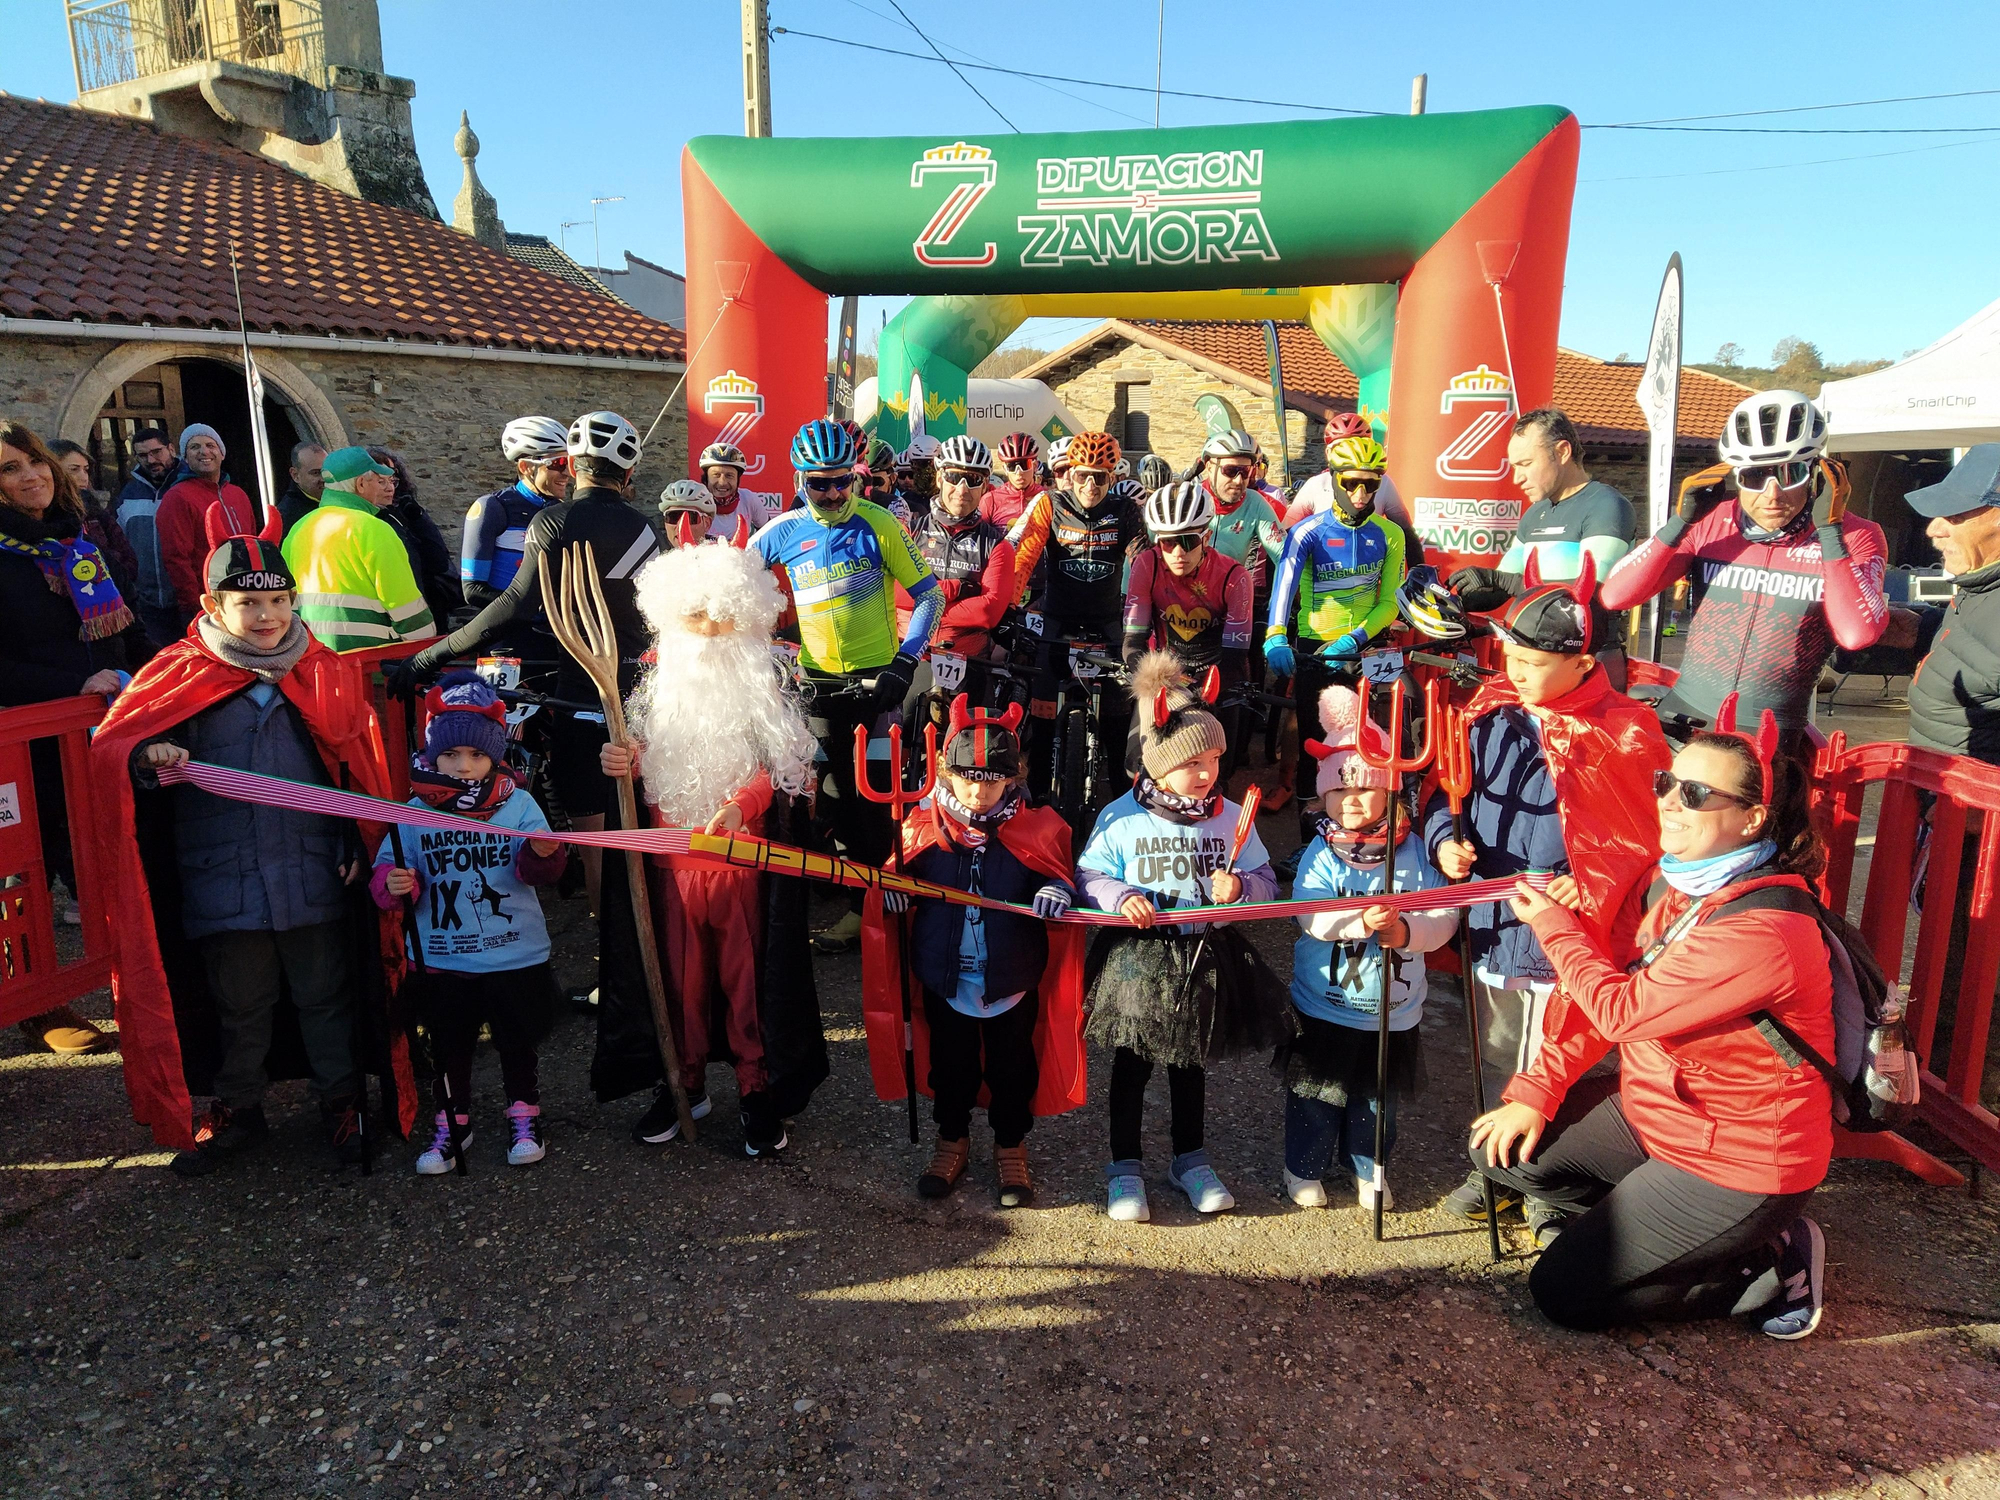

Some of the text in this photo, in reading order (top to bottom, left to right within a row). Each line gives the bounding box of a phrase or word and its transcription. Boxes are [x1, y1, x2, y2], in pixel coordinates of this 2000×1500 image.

[1017, 207, 1281, 267] ZAMORA
[1907, 395, 1977, 408] SmartChip
[967, 404, 1025, 421] martChip
[950, 559, 981, 573] RURAL
[1316, 560, 1343, 573] MTB
[237, 571, 287, 589] UFONES
[1703, 561, 1825, 602] VINTOROBIKE
[936, 663, 961, 681] 171
[1373, 661, 1394, 677] 74
[487, 672, 507, 687] 18
[961, 770, 1006, 781] UFONES
[420, 830, 481, 852] MARCHA
[1135, 837, 1226, 856] MARCHA MTB
[425, 844, 512, 876] UFONES
[1137, 853, 1227, 885] UFONES
[429, 880, 463, 931] IX
[1328, 940, 1368, 994] IX
